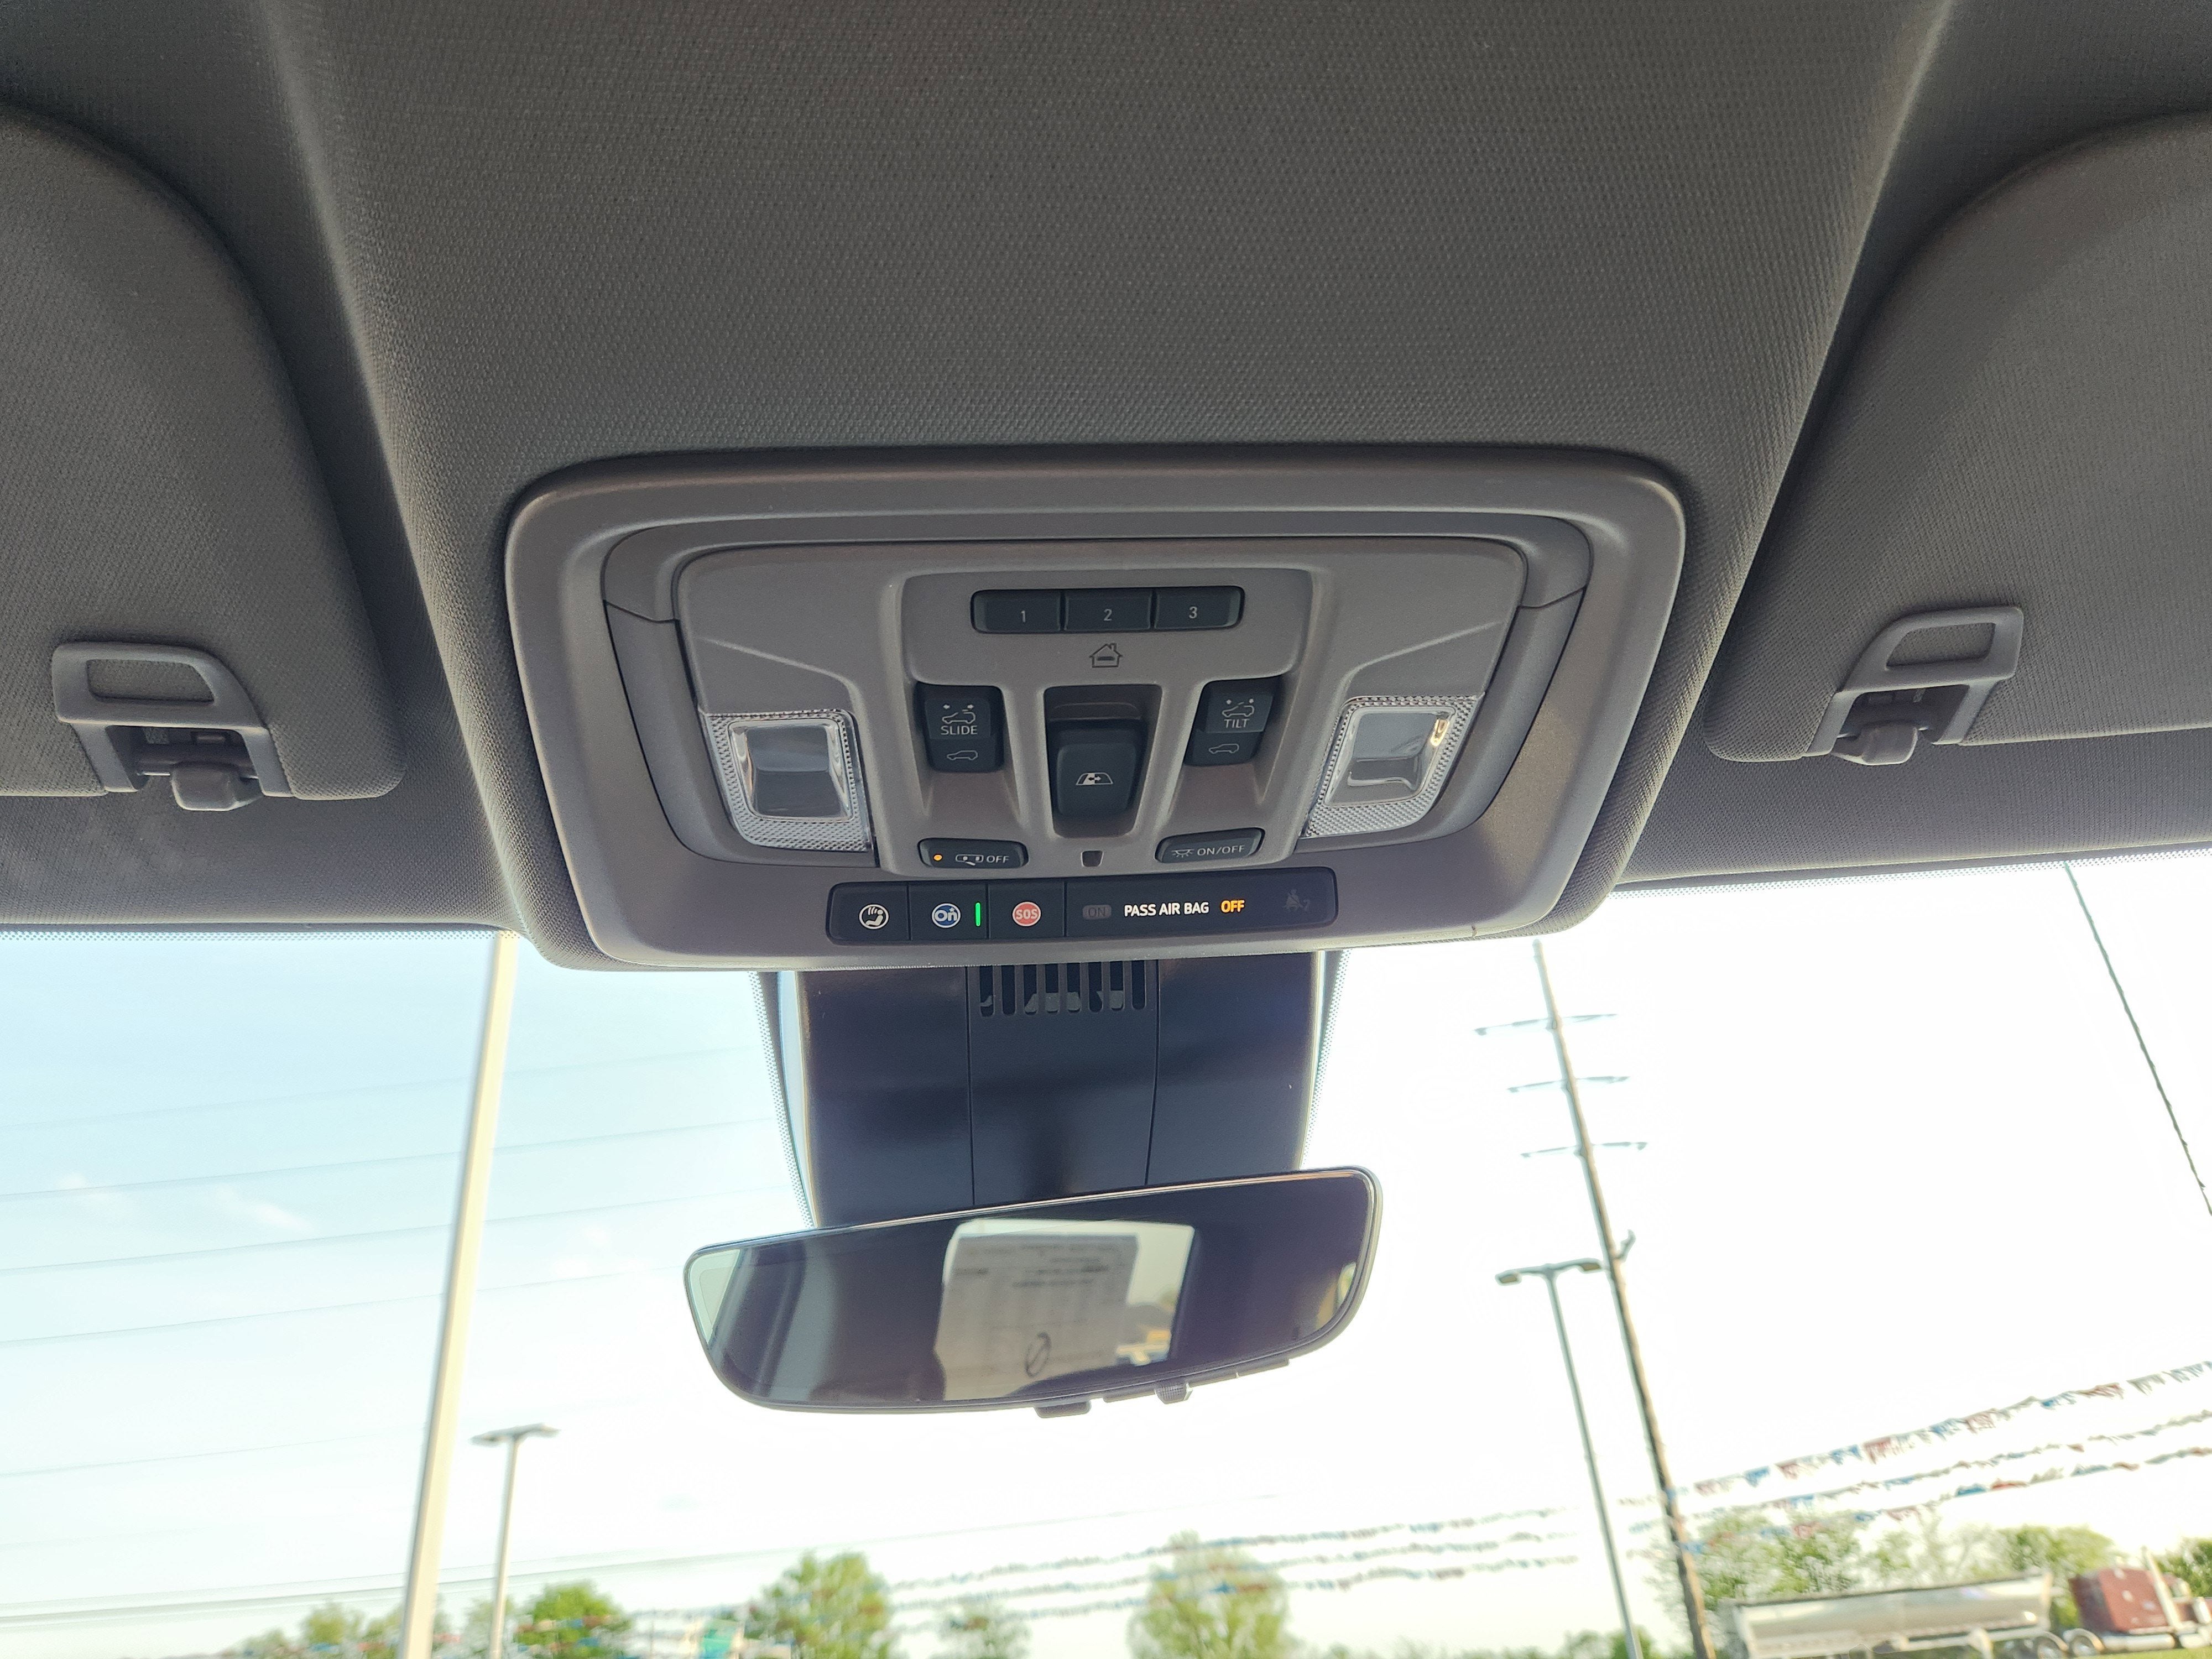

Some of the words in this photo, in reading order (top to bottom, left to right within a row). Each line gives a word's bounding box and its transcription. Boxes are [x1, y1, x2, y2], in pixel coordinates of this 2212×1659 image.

[1021, 610, 1026, 623] 1
[1103, 609, 1113, 621] 2
[1189, 606, 1198, 619] 3
[1223, 718, 1250, 728] TILT
[940, 725, 978, 735] SLIDE
[1197, 844, 1245, 856] ON/OFF
[986, 855, 1010, 864] OFF
[933, 907, 958, 922] On
[1015, 908, 1039, 920] SOS
[1088, 906, 1105, 918] ON
[1124, 904, 1157, 917] PASS
[1159, 902, 1181, 916] AIR
[1183, 901, 1209, 915] BAG
[1220, 900, 1245, 913] OFF
